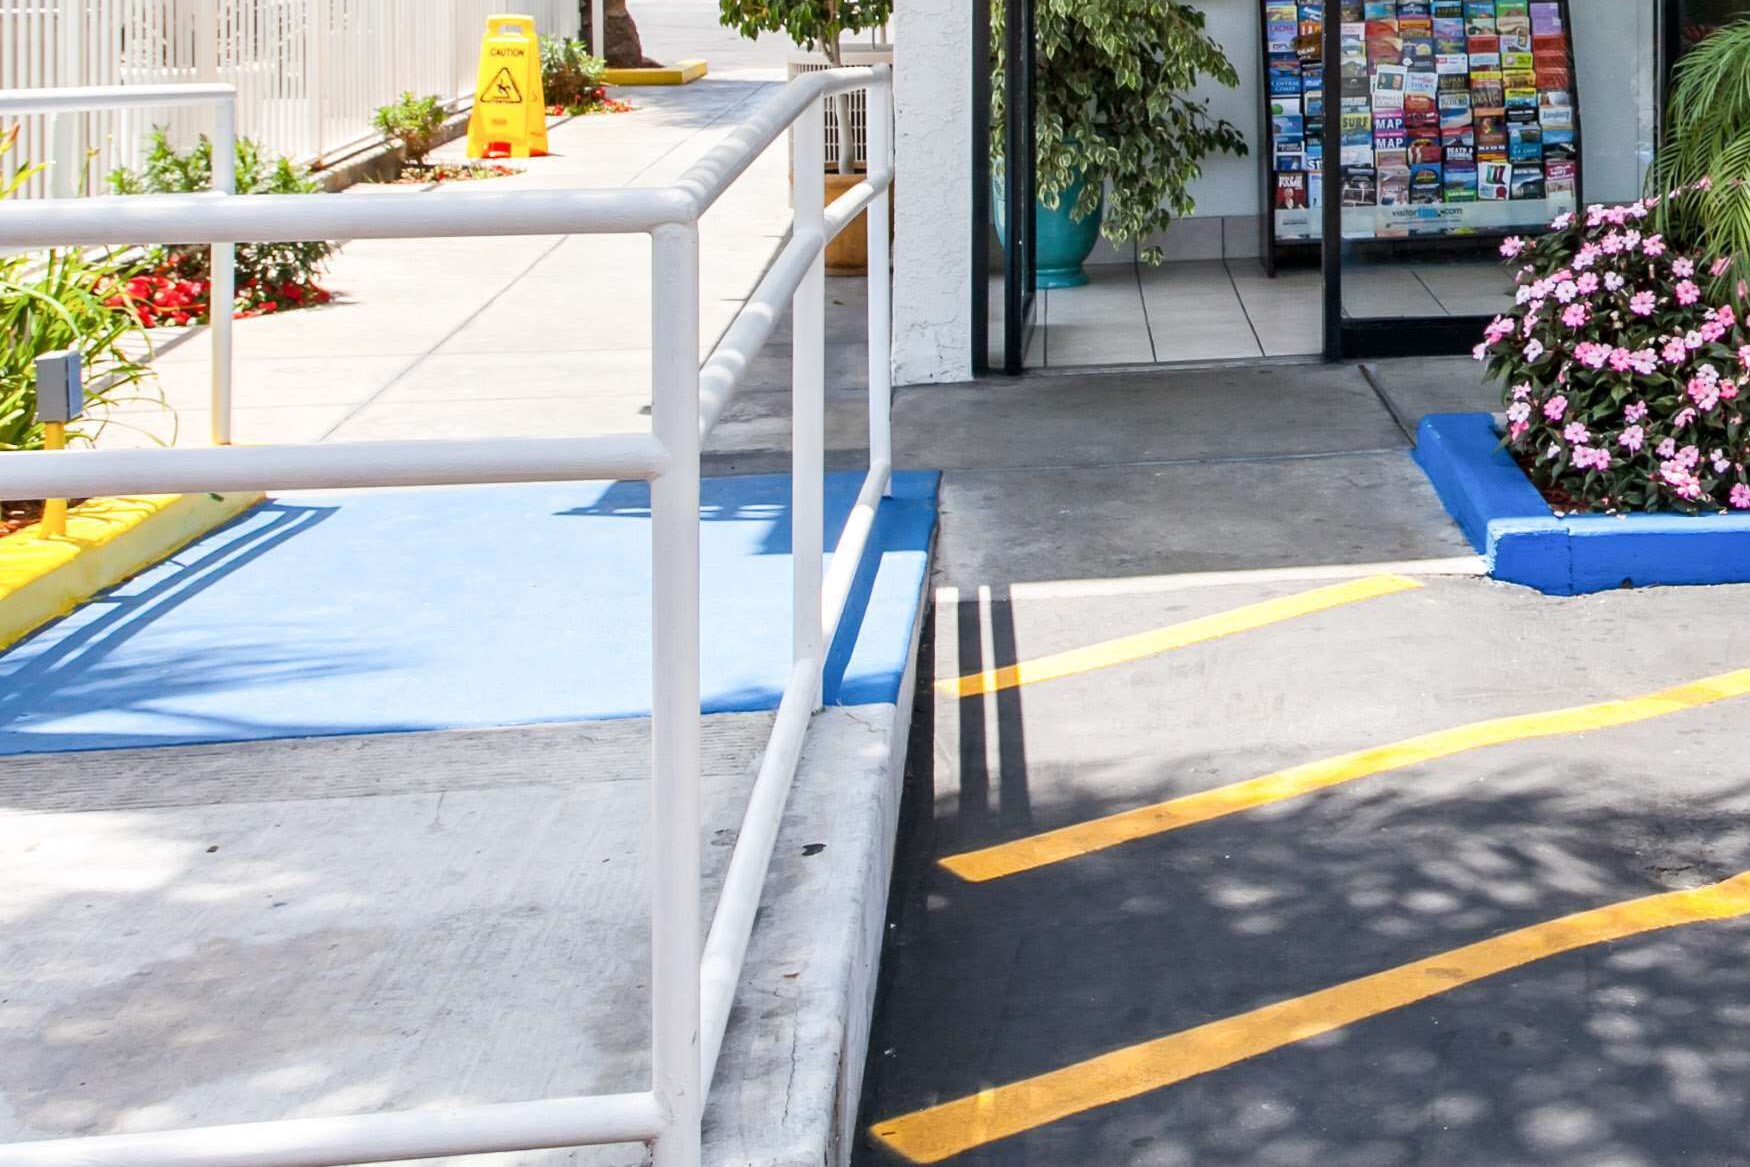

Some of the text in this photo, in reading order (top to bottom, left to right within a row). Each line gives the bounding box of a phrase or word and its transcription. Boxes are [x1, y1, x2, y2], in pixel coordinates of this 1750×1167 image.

[489, 47, 525, 59] CAUTION
[1342, 116, 1368, 129] SURF
[1375, 118, 1403, 131] MAP
[1376, 137, 1404, 150] MAP
